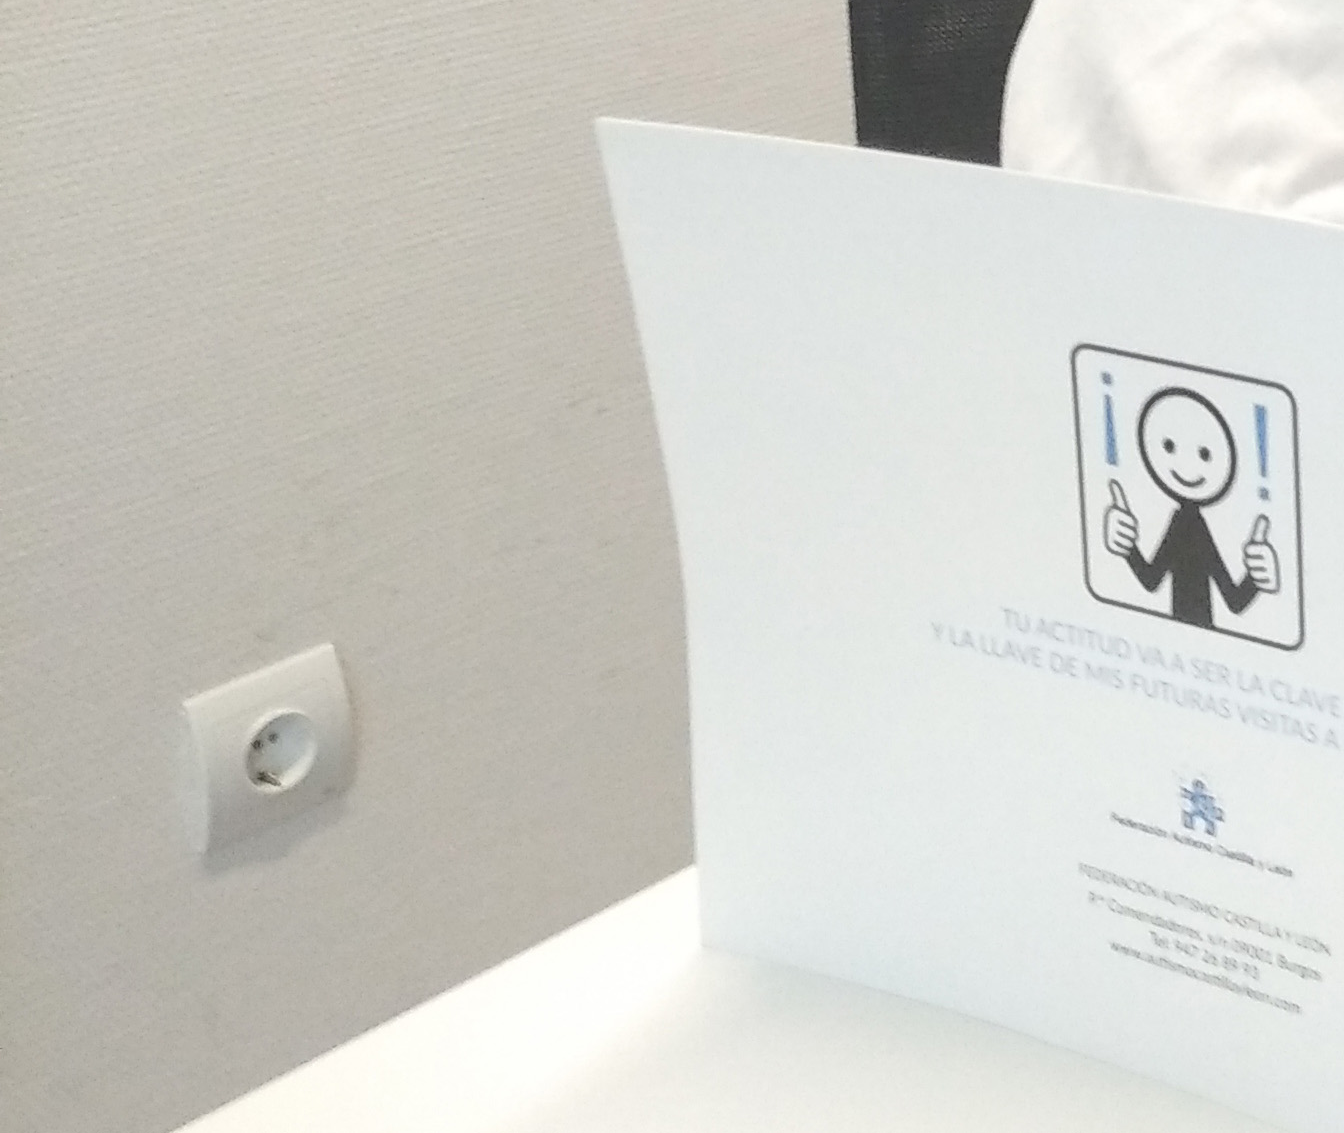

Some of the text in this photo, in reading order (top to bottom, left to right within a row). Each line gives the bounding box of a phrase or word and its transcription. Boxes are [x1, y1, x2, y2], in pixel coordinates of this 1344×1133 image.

[949, 627, 977, 651] LA
[979, 634, 1043, 669] LLAVE
[1049, 651, 1079, 678] DE
[1083, 660, 1125, 690] MIS
[1130, 673, 1232, 720] FUTURAS
[1236, 703, 1318, 745] VISITAS
[1323, 728, 1341, 750] A
[1000, 607, 1031, 634] TU
[1033, 618, 1131, 659] ACTITUD
[1135, 642, 1166, 668] VA
[1170, 653, 1186, 673] A
[1190, 657, 1231, 687] SER
[1235, 669, 1266, 697] LA
[1269, 679, 1342, 719] CLAVE
